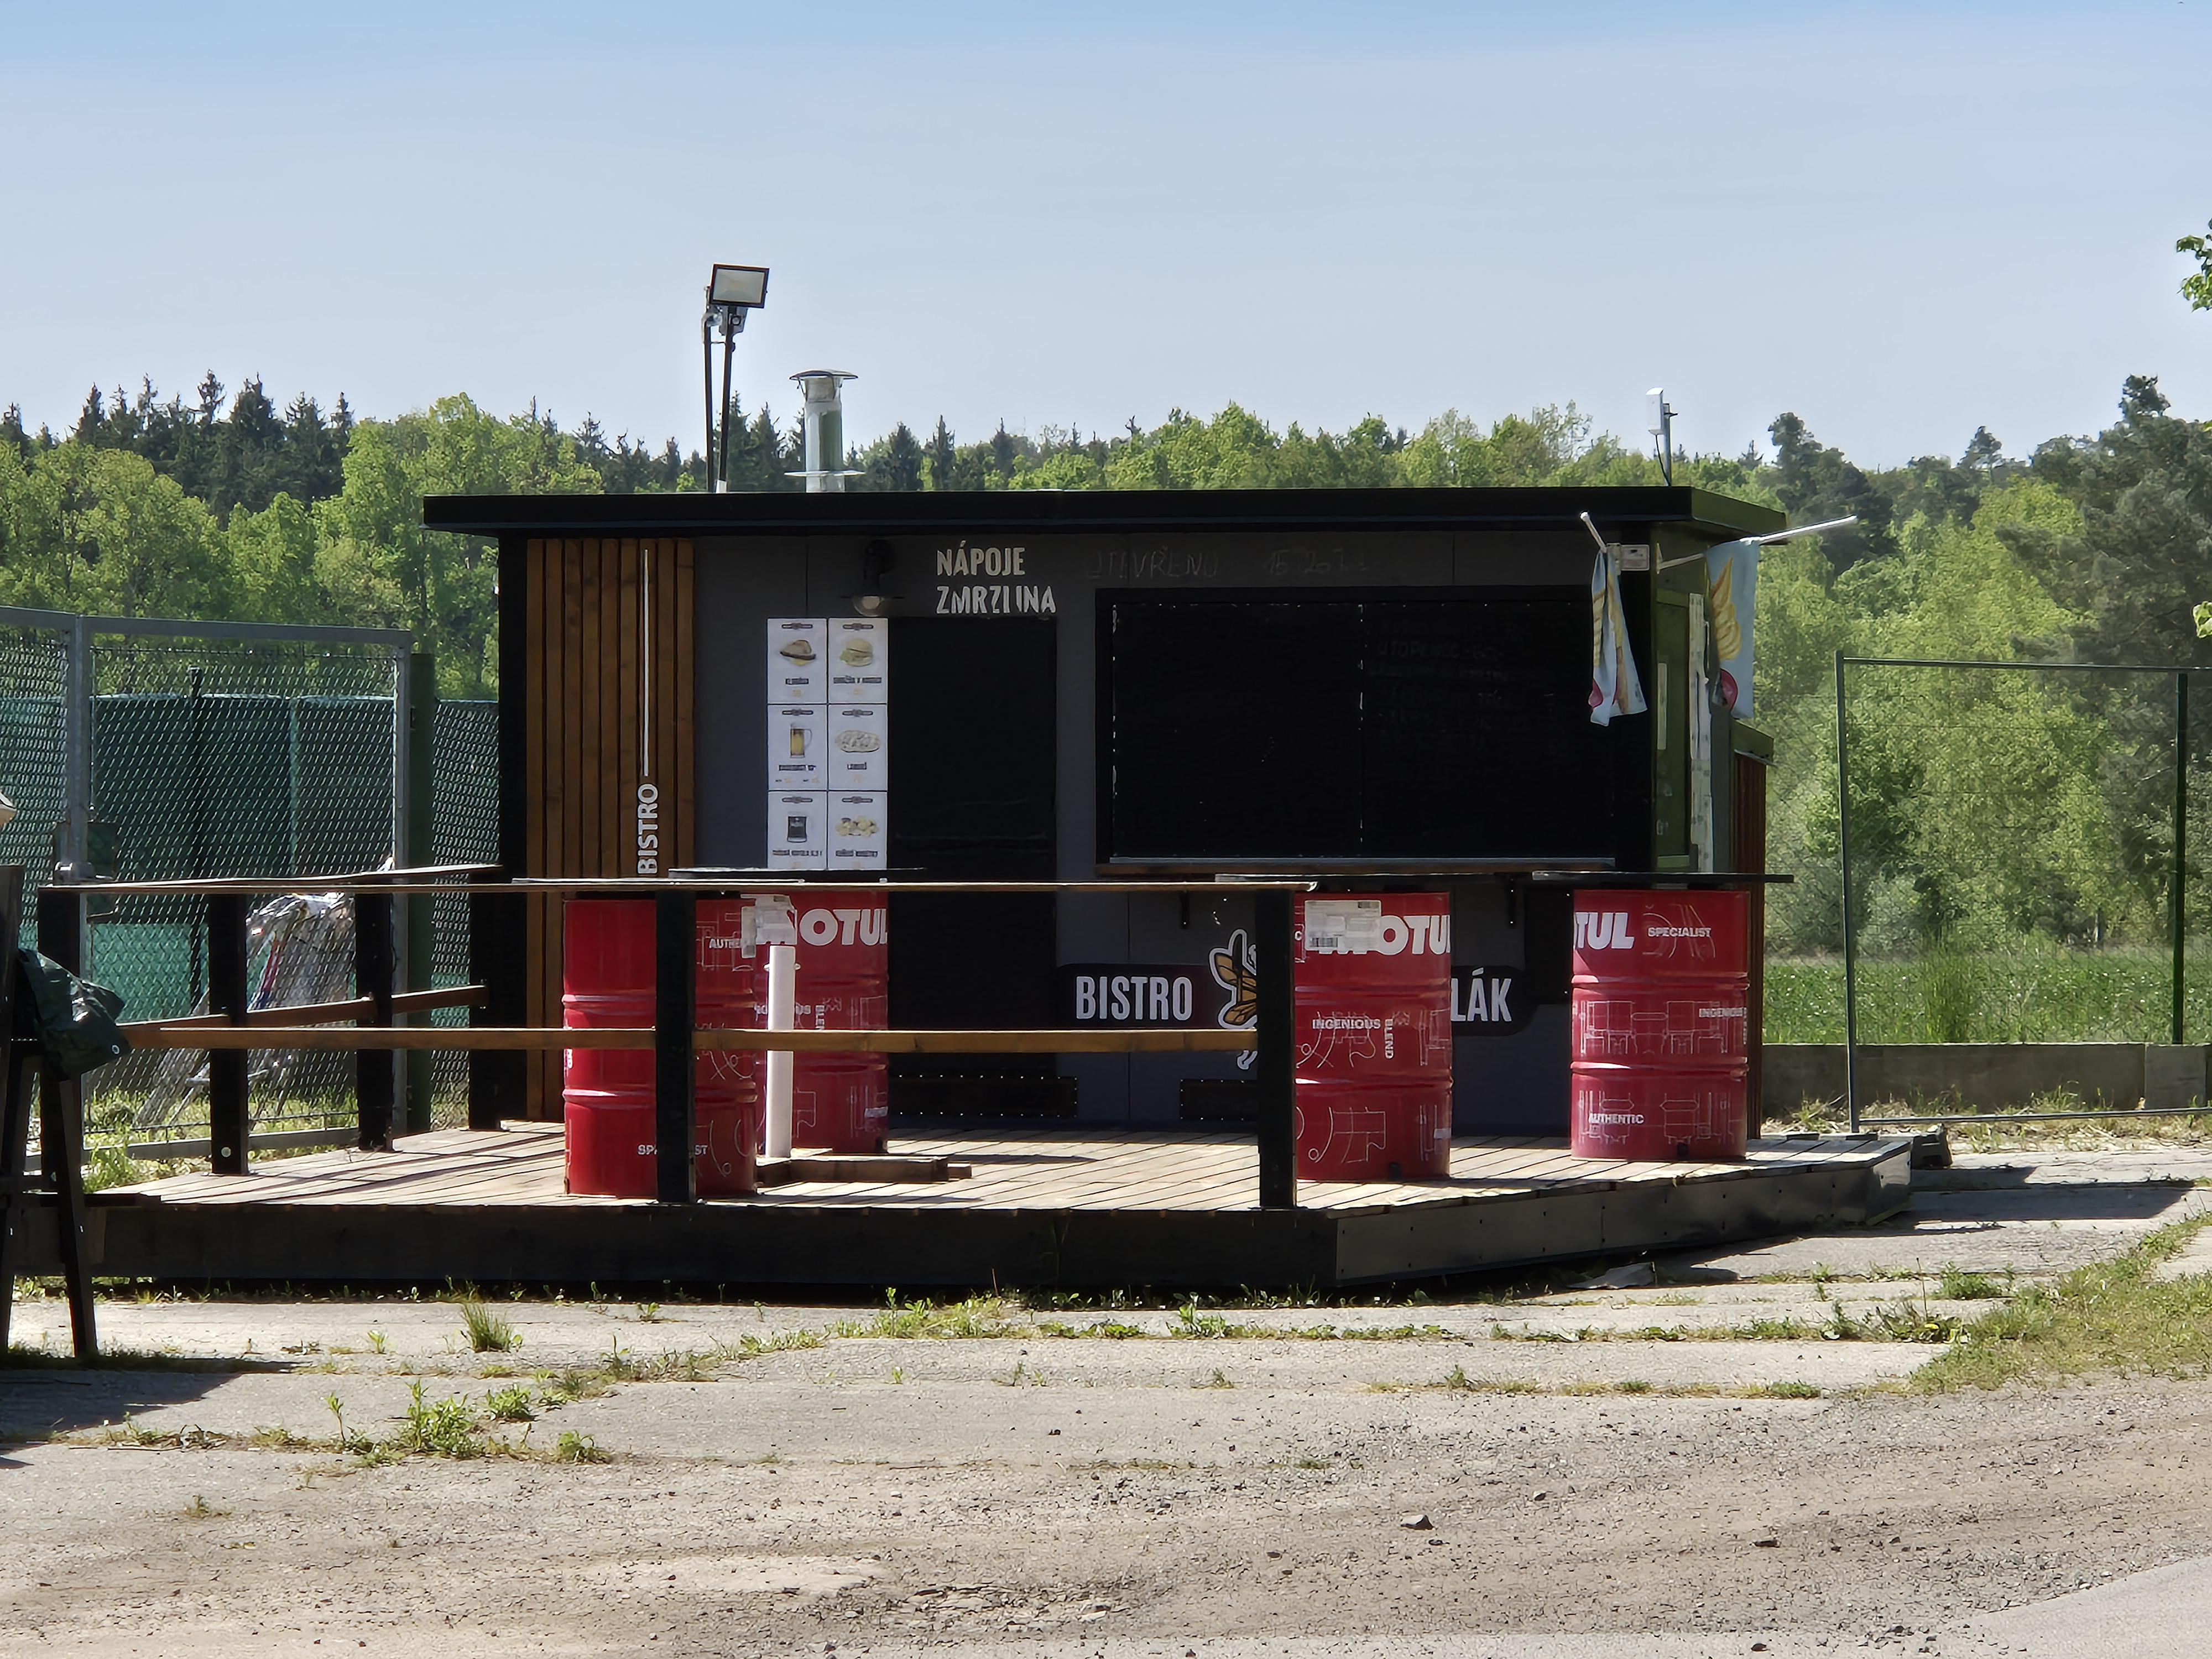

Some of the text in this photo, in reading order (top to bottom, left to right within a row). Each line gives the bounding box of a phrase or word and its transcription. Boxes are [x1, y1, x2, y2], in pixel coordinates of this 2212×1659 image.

[937, 540, 1025, 576] NÁPOJE
[638, 784, 658, 874] BISTRO
[1319, 915, 1450, 956] OTU
[1574, 912, 1635, 950] TUL
[1648, 927, 1712, 937] SPECIALIST
[1076, 967, 1512, 1022] BISTRO LÁK
[1312, 1019, 1381, 1029] INGENIOUS
[1384, 1019, 1394, 1059] BLEND
